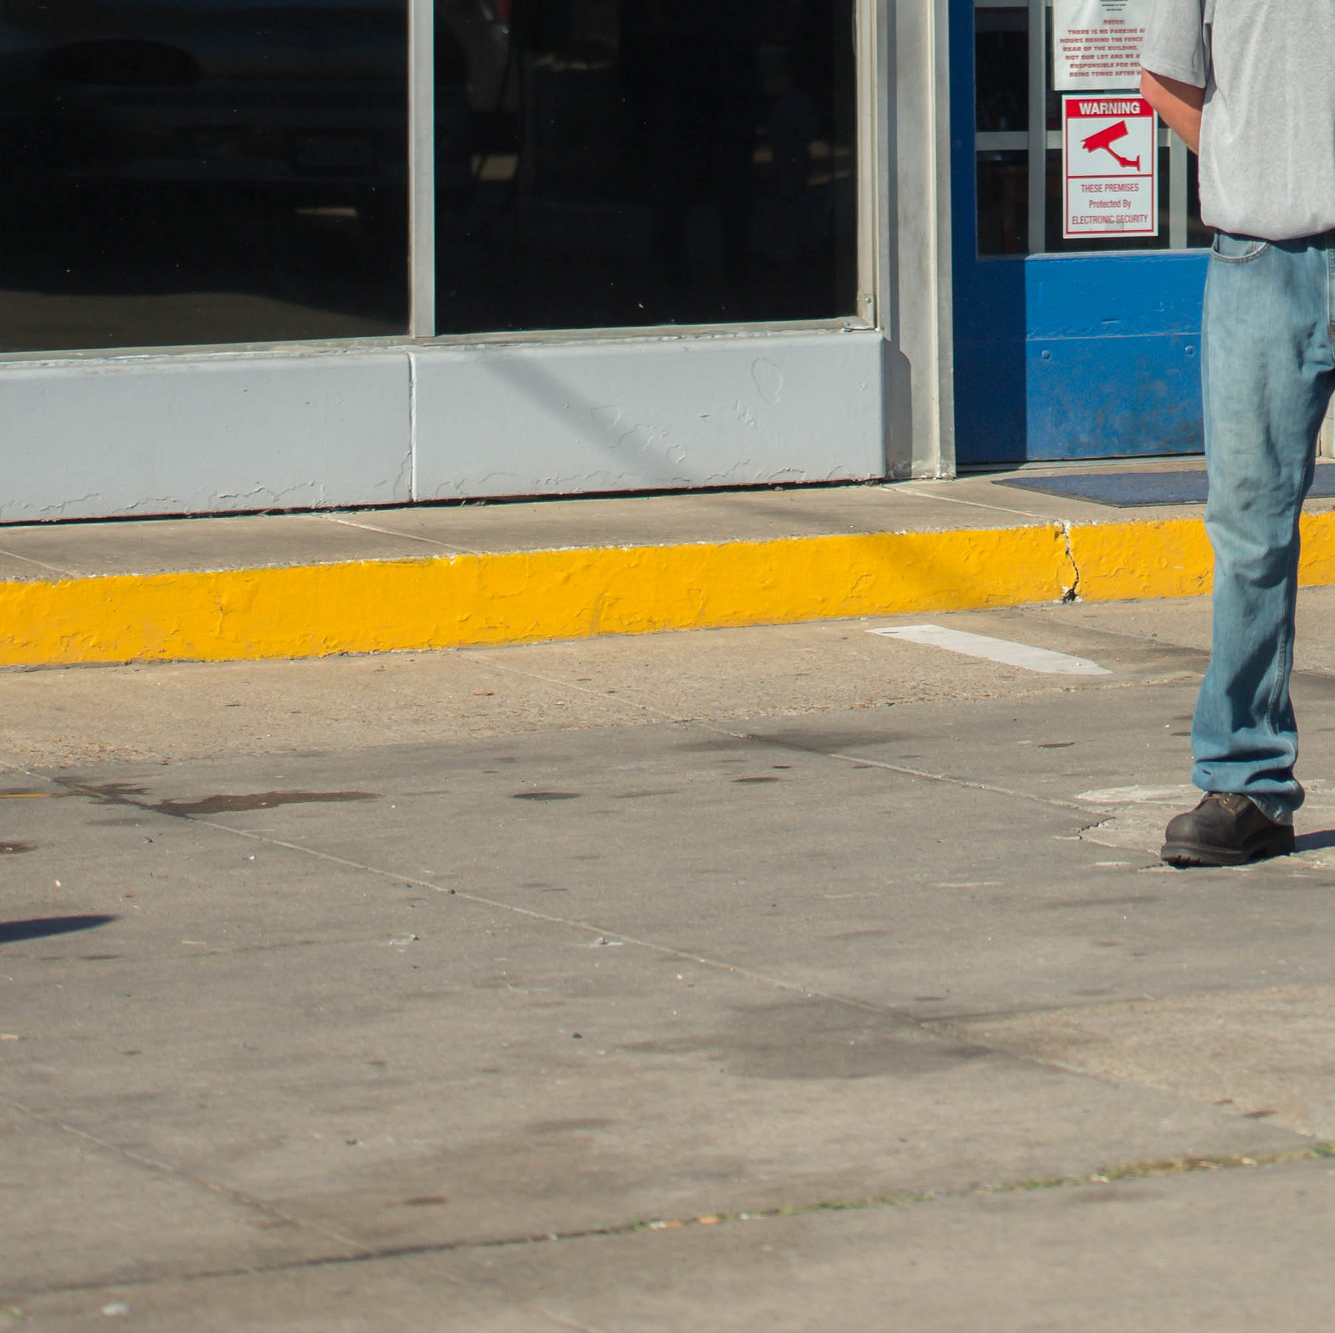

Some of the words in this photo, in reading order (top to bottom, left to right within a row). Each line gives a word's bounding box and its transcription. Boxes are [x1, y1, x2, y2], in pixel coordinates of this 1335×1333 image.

[1079, 102, 1140, 115] WARNING
[1081, 184, 1102, 193] THESE
[1105, 183, 1139, 192] PREMISES
[1089, 199, 1121, 209] Protected
[1123, 199, 1131, 209] By
[1072, 216, 1114, 225] ELECTRONIC
[1116, 214, 1148, 224] SECURITY
